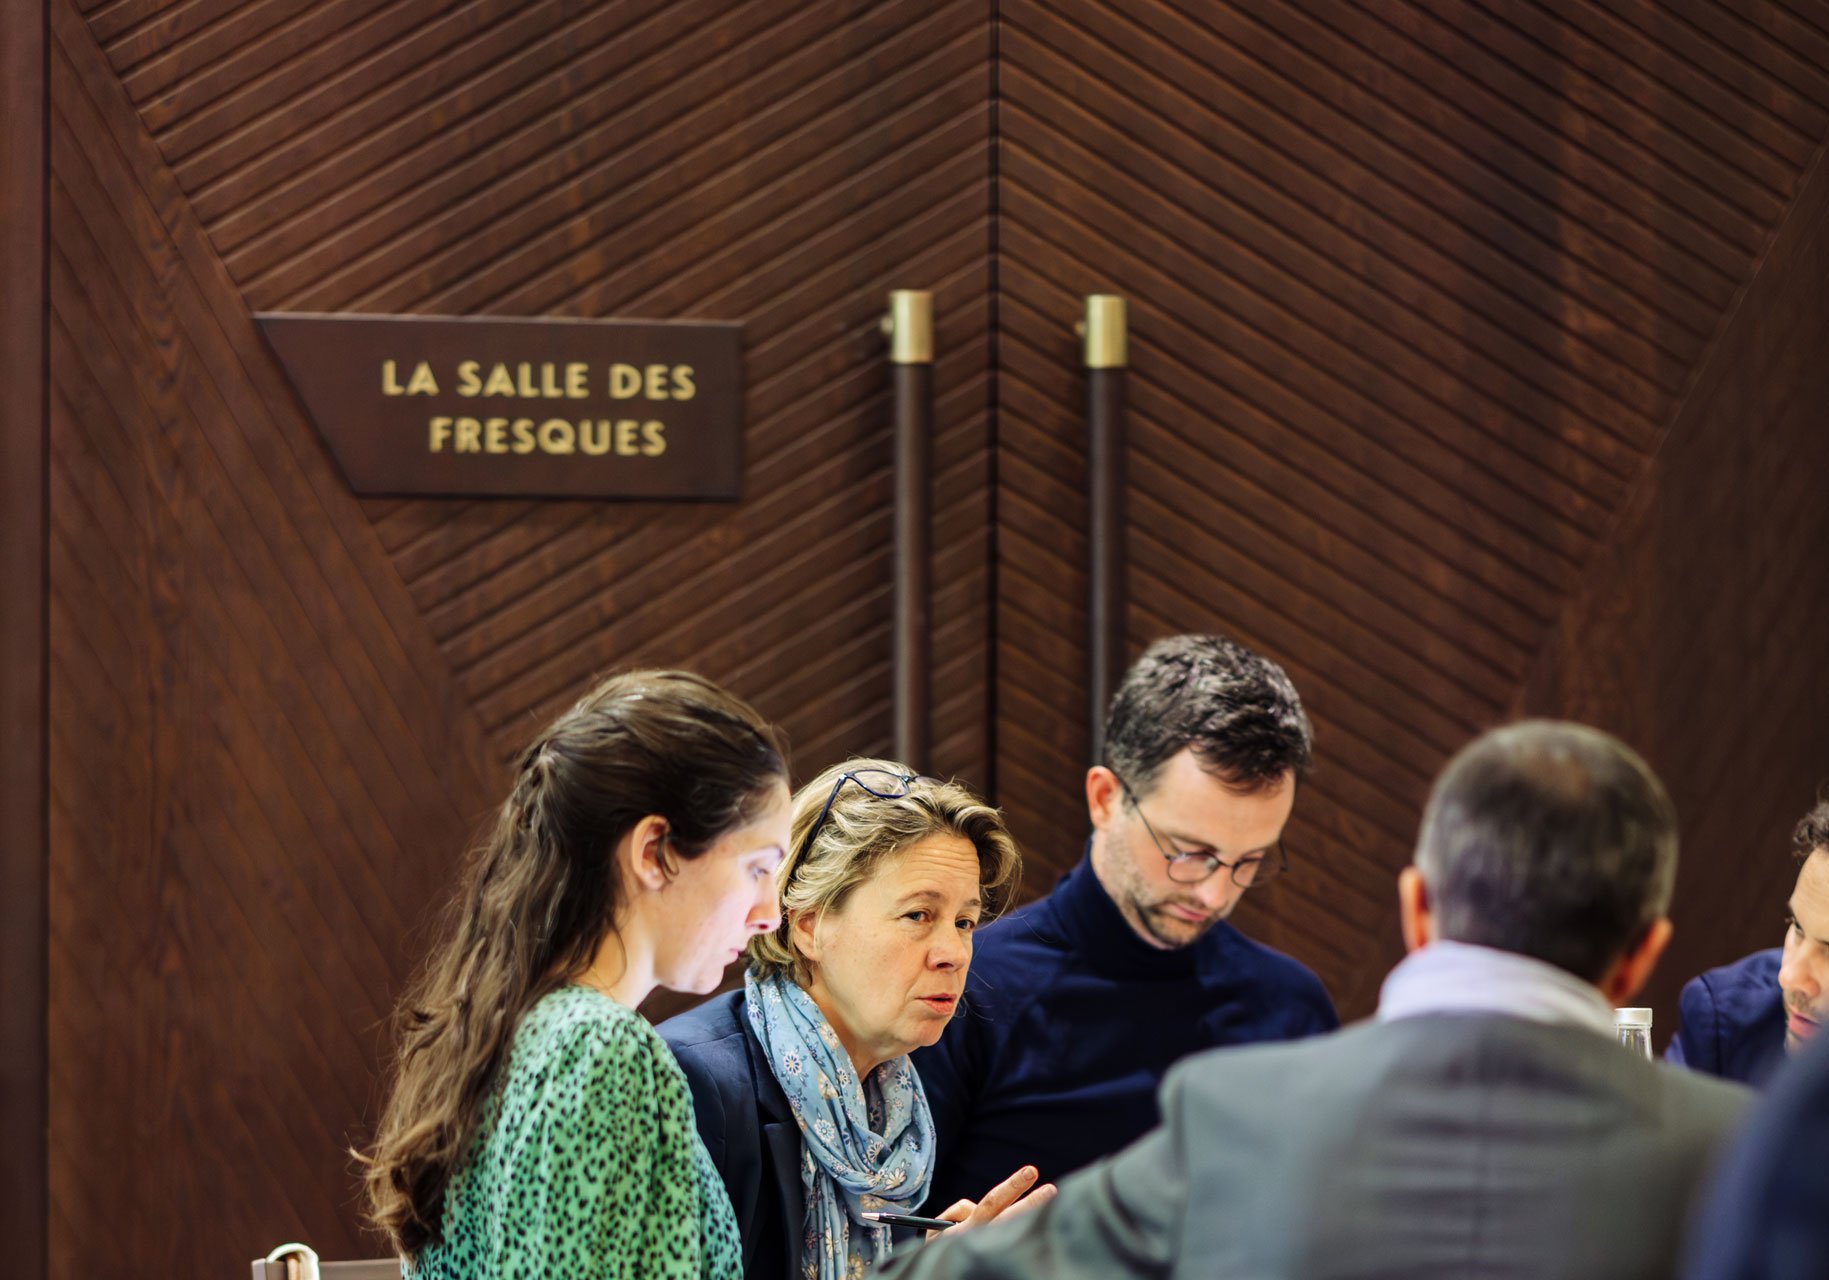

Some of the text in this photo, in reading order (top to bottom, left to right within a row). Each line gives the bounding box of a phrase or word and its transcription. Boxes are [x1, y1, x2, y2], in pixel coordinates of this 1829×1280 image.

[382, 360, 696, 400] LA SALLE DES
[429, 417, 667, 456] FRESQUES
